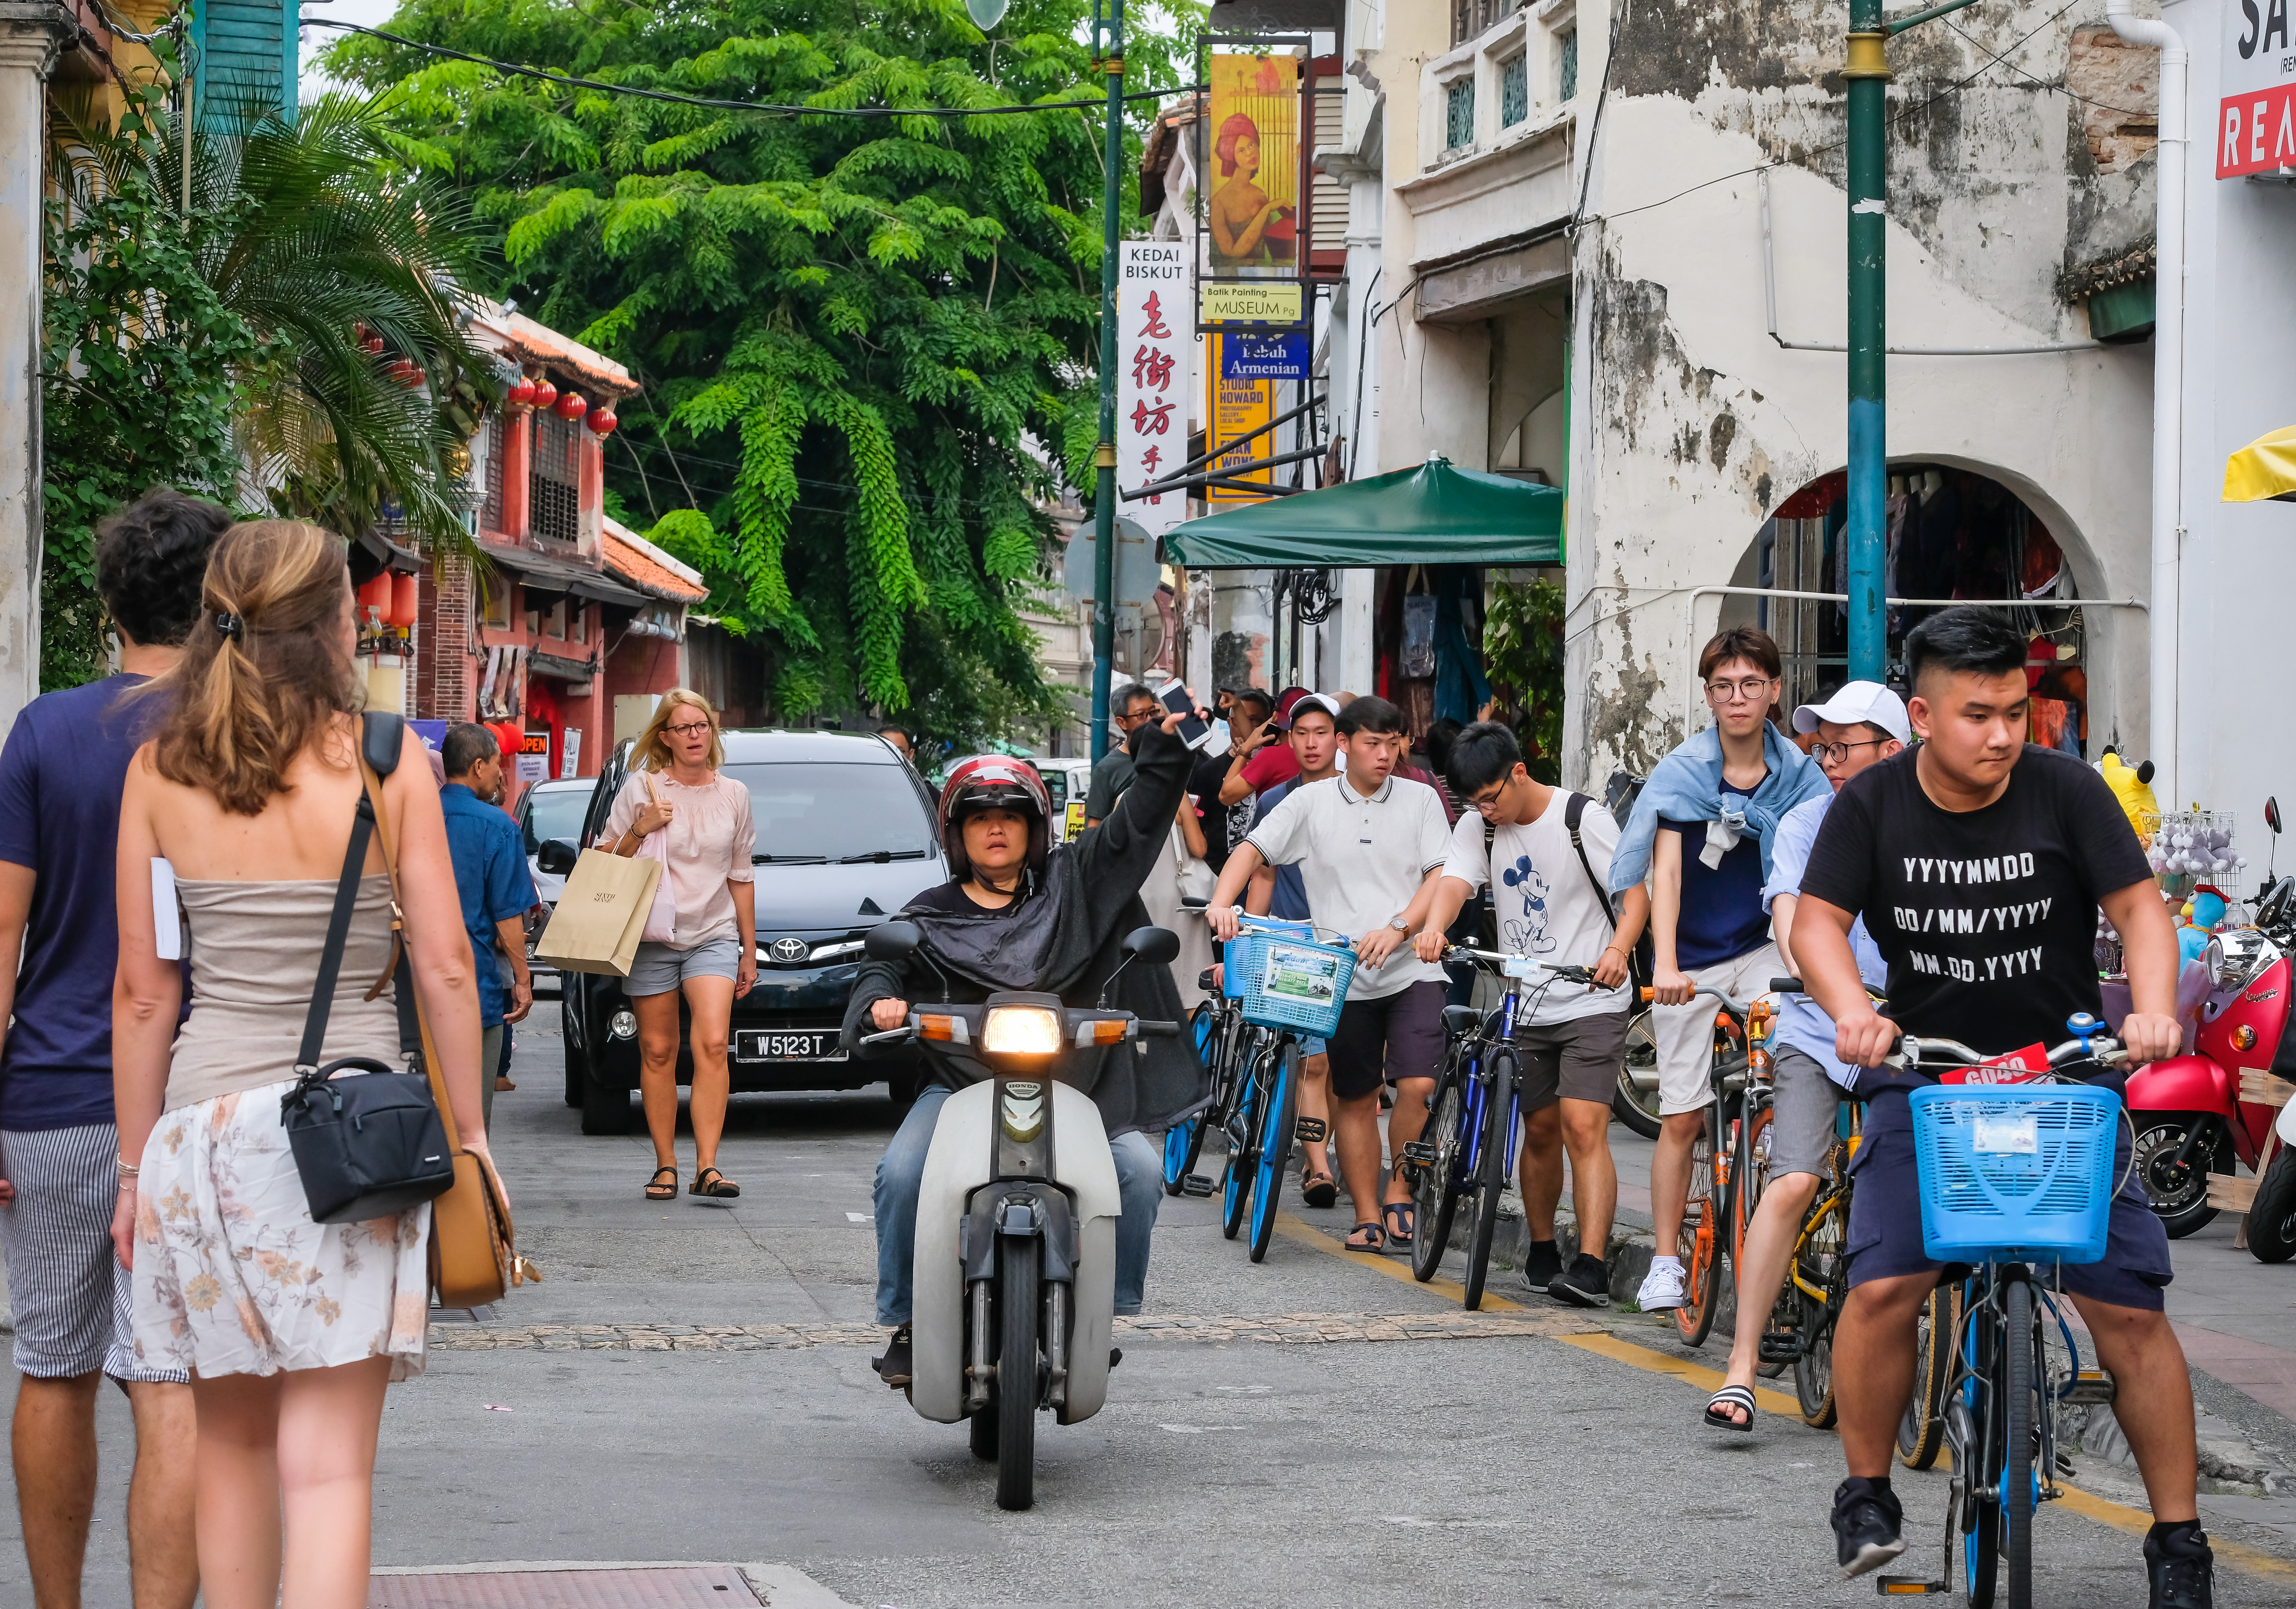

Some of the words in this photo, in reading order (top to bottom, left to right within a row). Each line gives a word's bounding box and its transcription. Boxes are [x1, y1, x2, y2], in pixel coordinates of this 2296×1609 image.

[1131, 248, 1179, 262] KEDAI
[1126, 265, 1183, 279] BISKUT
[1232, 288, 1267, 298] Painting
[1215, 302, 1279, 314] MUSEUM
[1283, 307, 1295, 317] Pg
[1243, 345, 1286, 358] Lebuh
[1230, 360, 1300, 374] Armenian
[1220, 392, 1263, 403] HOWARD
[1903, 852, 2035, 884] YYYYMMDD
[1893, 897, 2053, 934] DD/MM/YYYY
[1909, 945, 2043, 982] MM.DD.YYYY
